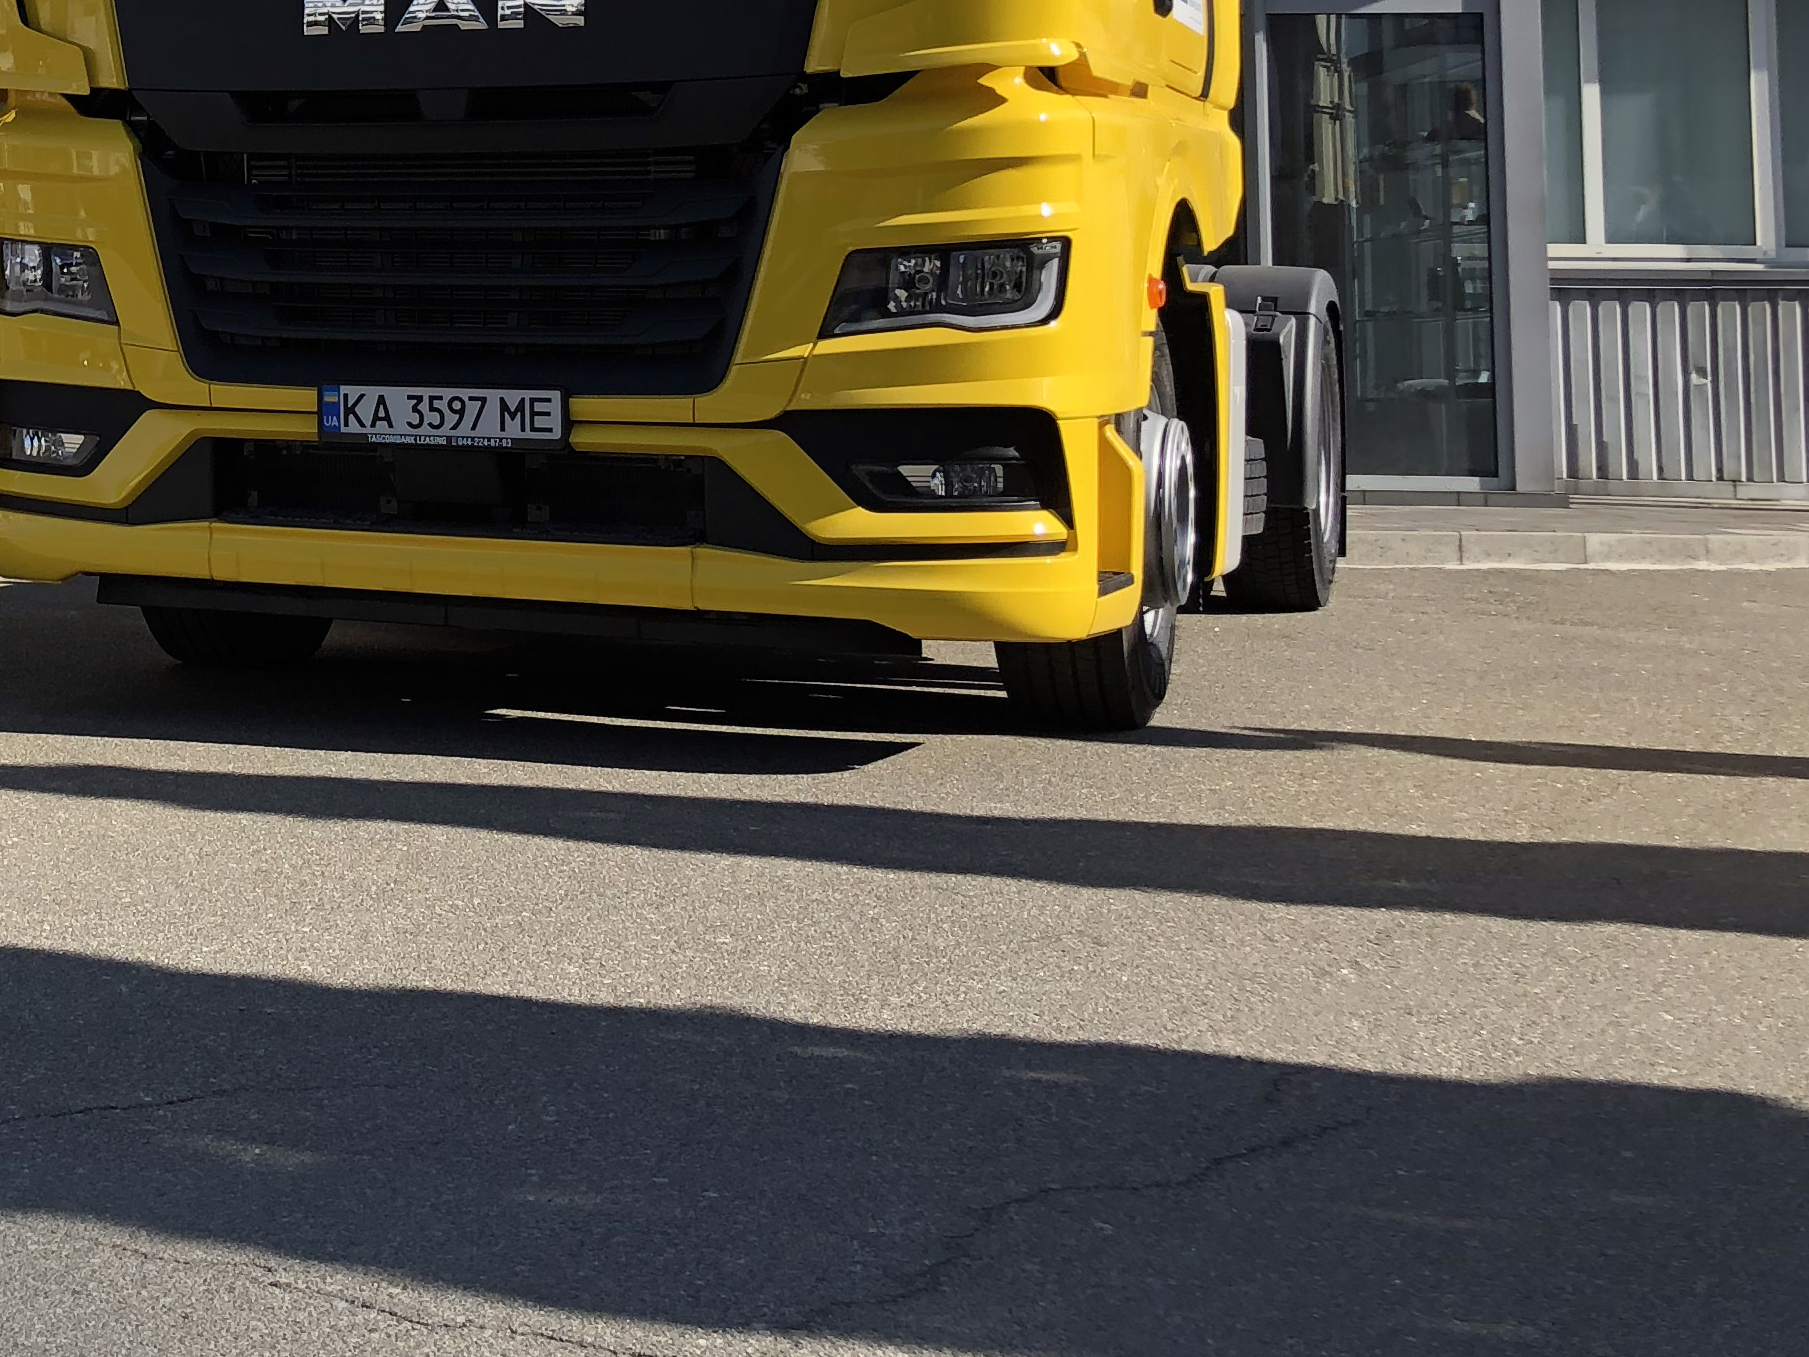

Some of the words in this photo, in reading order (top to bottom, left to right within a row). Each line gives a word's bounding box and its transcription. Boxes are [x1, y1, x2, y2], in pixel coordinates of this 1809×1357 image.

[323, 415, 339, 427] UA
[343, 393, 394, 428] KA
[405, 395, 488, 431] 3597
[499, 396, 554, 433] ME
